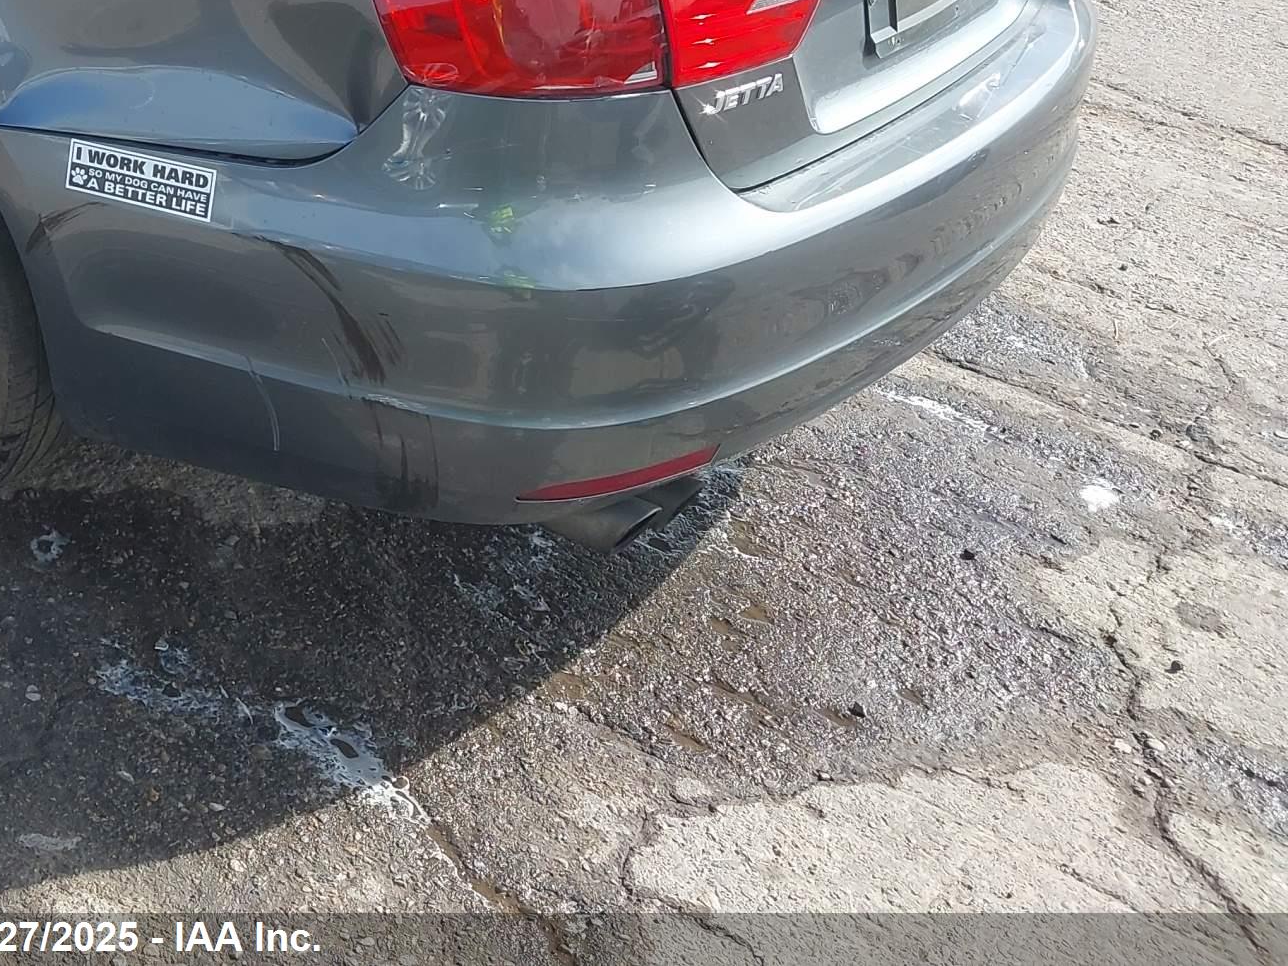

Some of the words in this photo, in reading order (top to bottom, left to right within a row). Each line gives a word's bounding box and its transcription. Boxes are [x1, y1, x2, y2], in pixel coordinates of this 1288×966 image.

[703, 73, 784, 115] JETTA
[76, 146, 83, 160] I
[88, 148, 146, 175] WORK
[152, 163, 209, 188] HARD
[88, 167, 103, 178] SO
[105, 171, 123, 183] MY
[125, 175, 148, 188] DOG
[150, 182, 175, 195] CAN
[177, 189, 207, 203] HAVE
[86, 177, 100, 190] A
[104, 180, 167, 207] BETTER
[171, 196, 206, 216] LIFE
